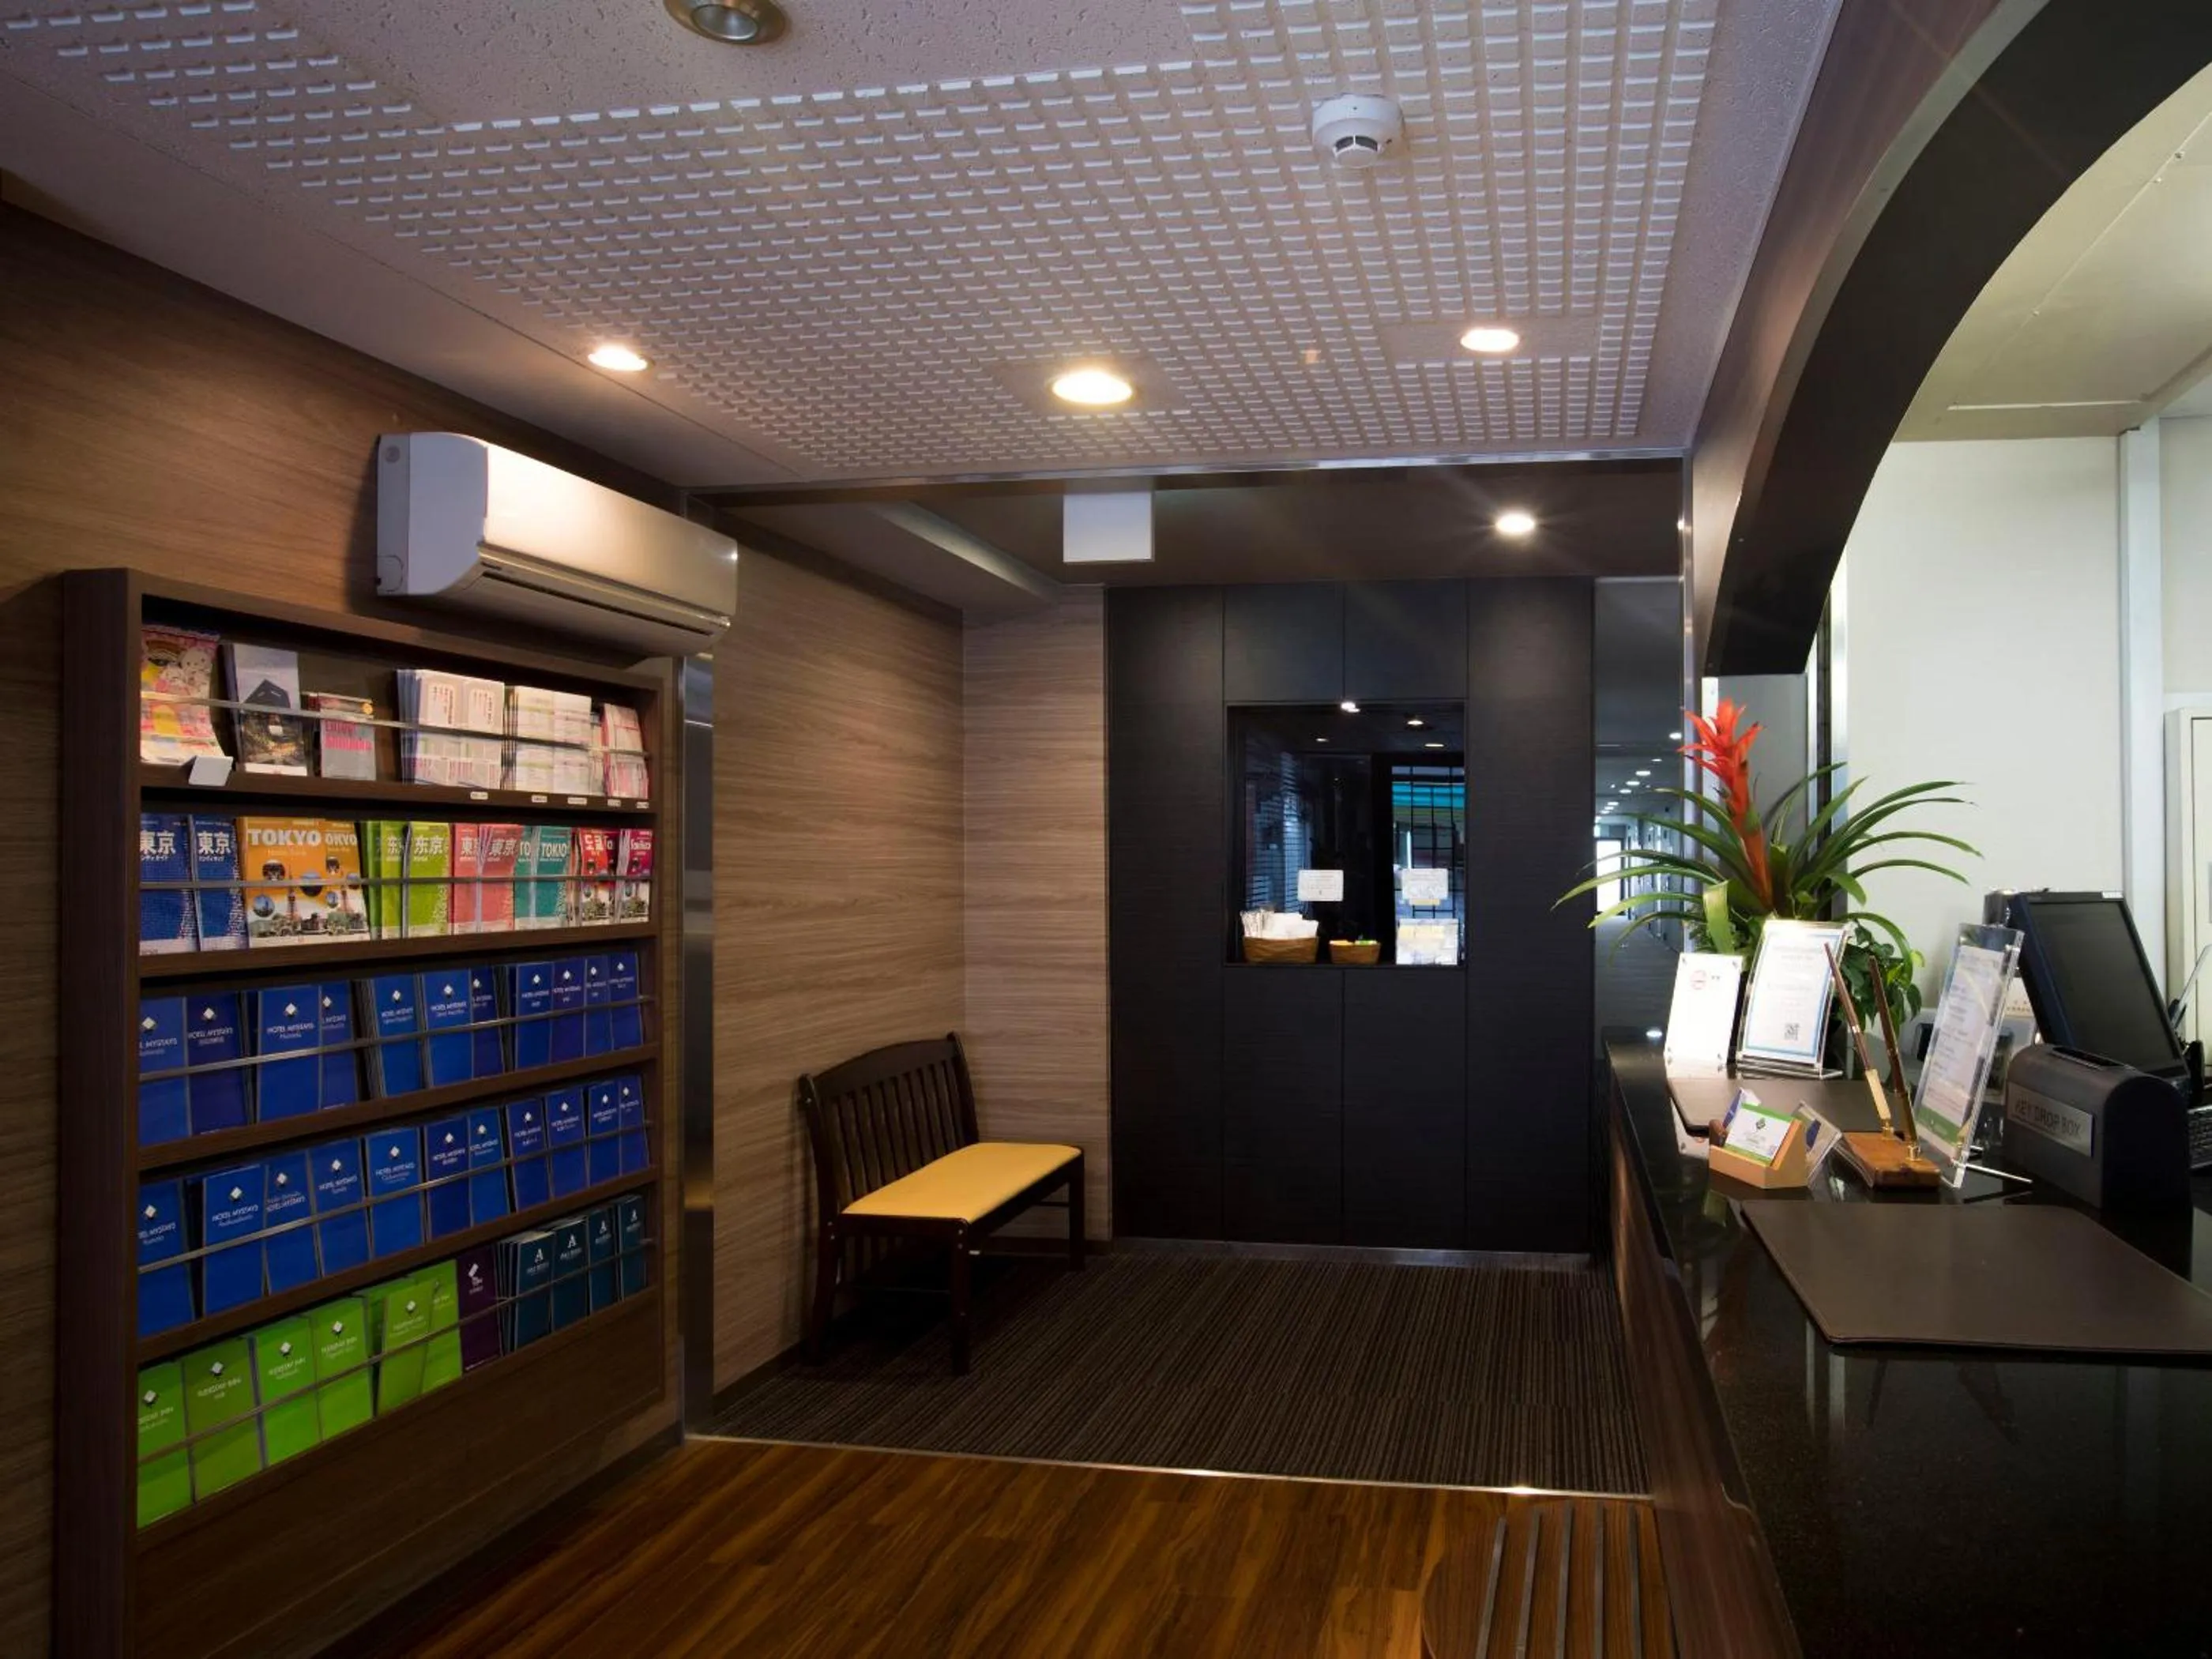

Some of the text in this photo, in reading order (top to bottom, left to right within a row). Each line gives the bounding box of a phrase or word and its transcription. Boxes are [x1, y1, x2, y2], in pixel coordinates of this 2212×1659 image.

[140, 830, 176, 854] 東京
[198, 830, 231, 854] 東京
[247, 829, 322, 846] TOKYO
[325, 832, 358, 846] OKYO
[2034, 1106, 2060, 1130] DROP
[2062, 1116, 2081, 1136] BOX
